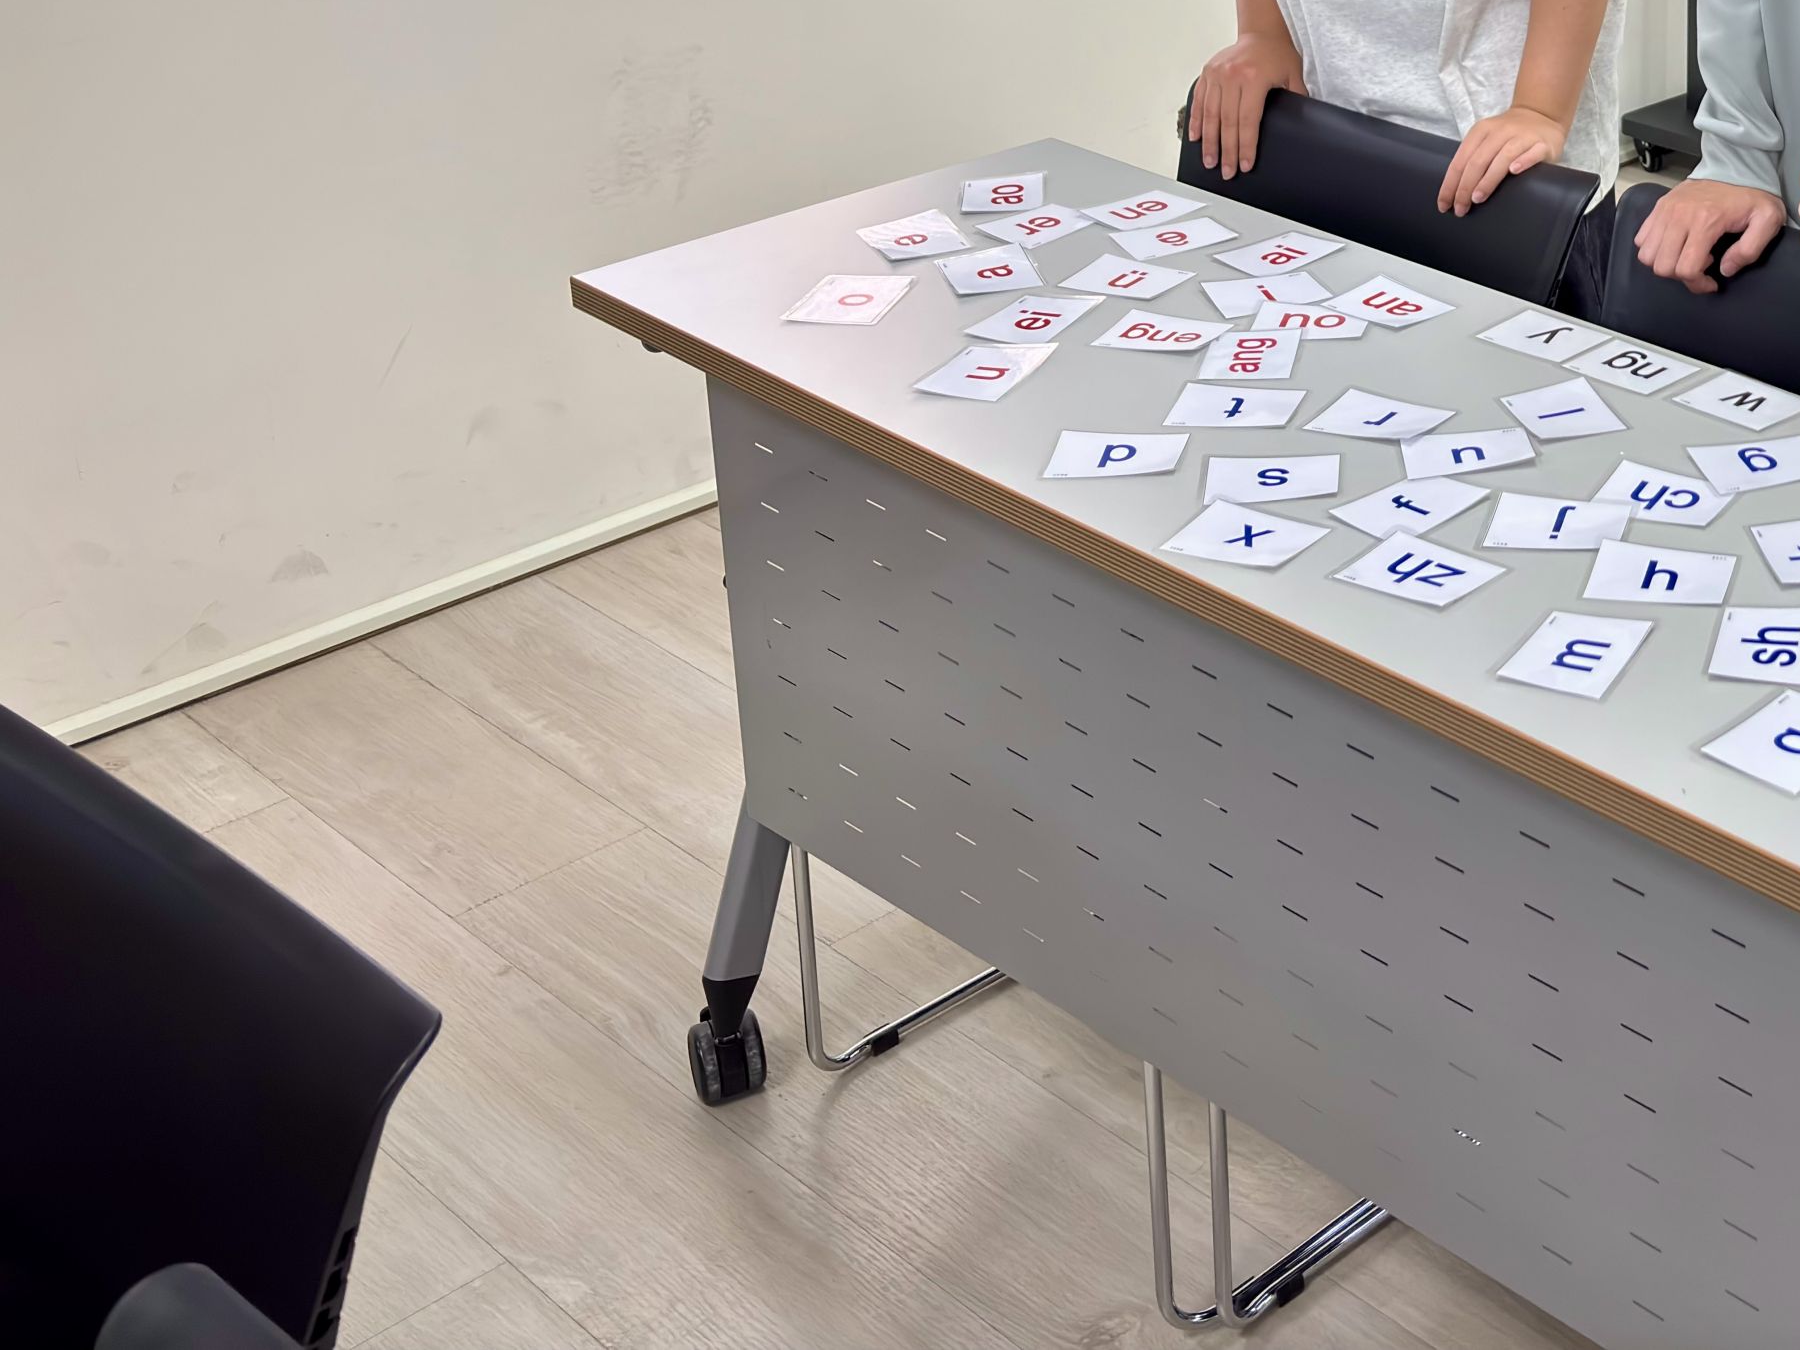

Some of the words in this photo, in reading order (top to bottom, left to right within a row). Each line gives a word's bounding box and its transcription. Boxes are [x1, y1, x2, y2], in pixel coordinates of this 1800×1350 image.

[991, 184, 1025, 205] ao
[1109, 200, 1169, 220] en
[1015, 216, 1061, 235] er
[1261, 244, 1308, 265] ai
[977, 264, 1013, 279] a
[1108, 270, 1148, 289] ü
[1362, 291, 1424, 316] an
[1014, 309, 1063, 331] ei
[1119, 322, 1202, 343] eng
[1229, 337, 1278, 374] ang
[1223, 397, 1245, 419] t
[1257, 467, 1291, 488] s
[1391, 494, 1431, 516] f
[1630, 479, 1701, 511] ch
[1224, 523, 1276, 549] x
[1386, 552, 1467, 588] zh
[1550, 637, 1613, 674] m
